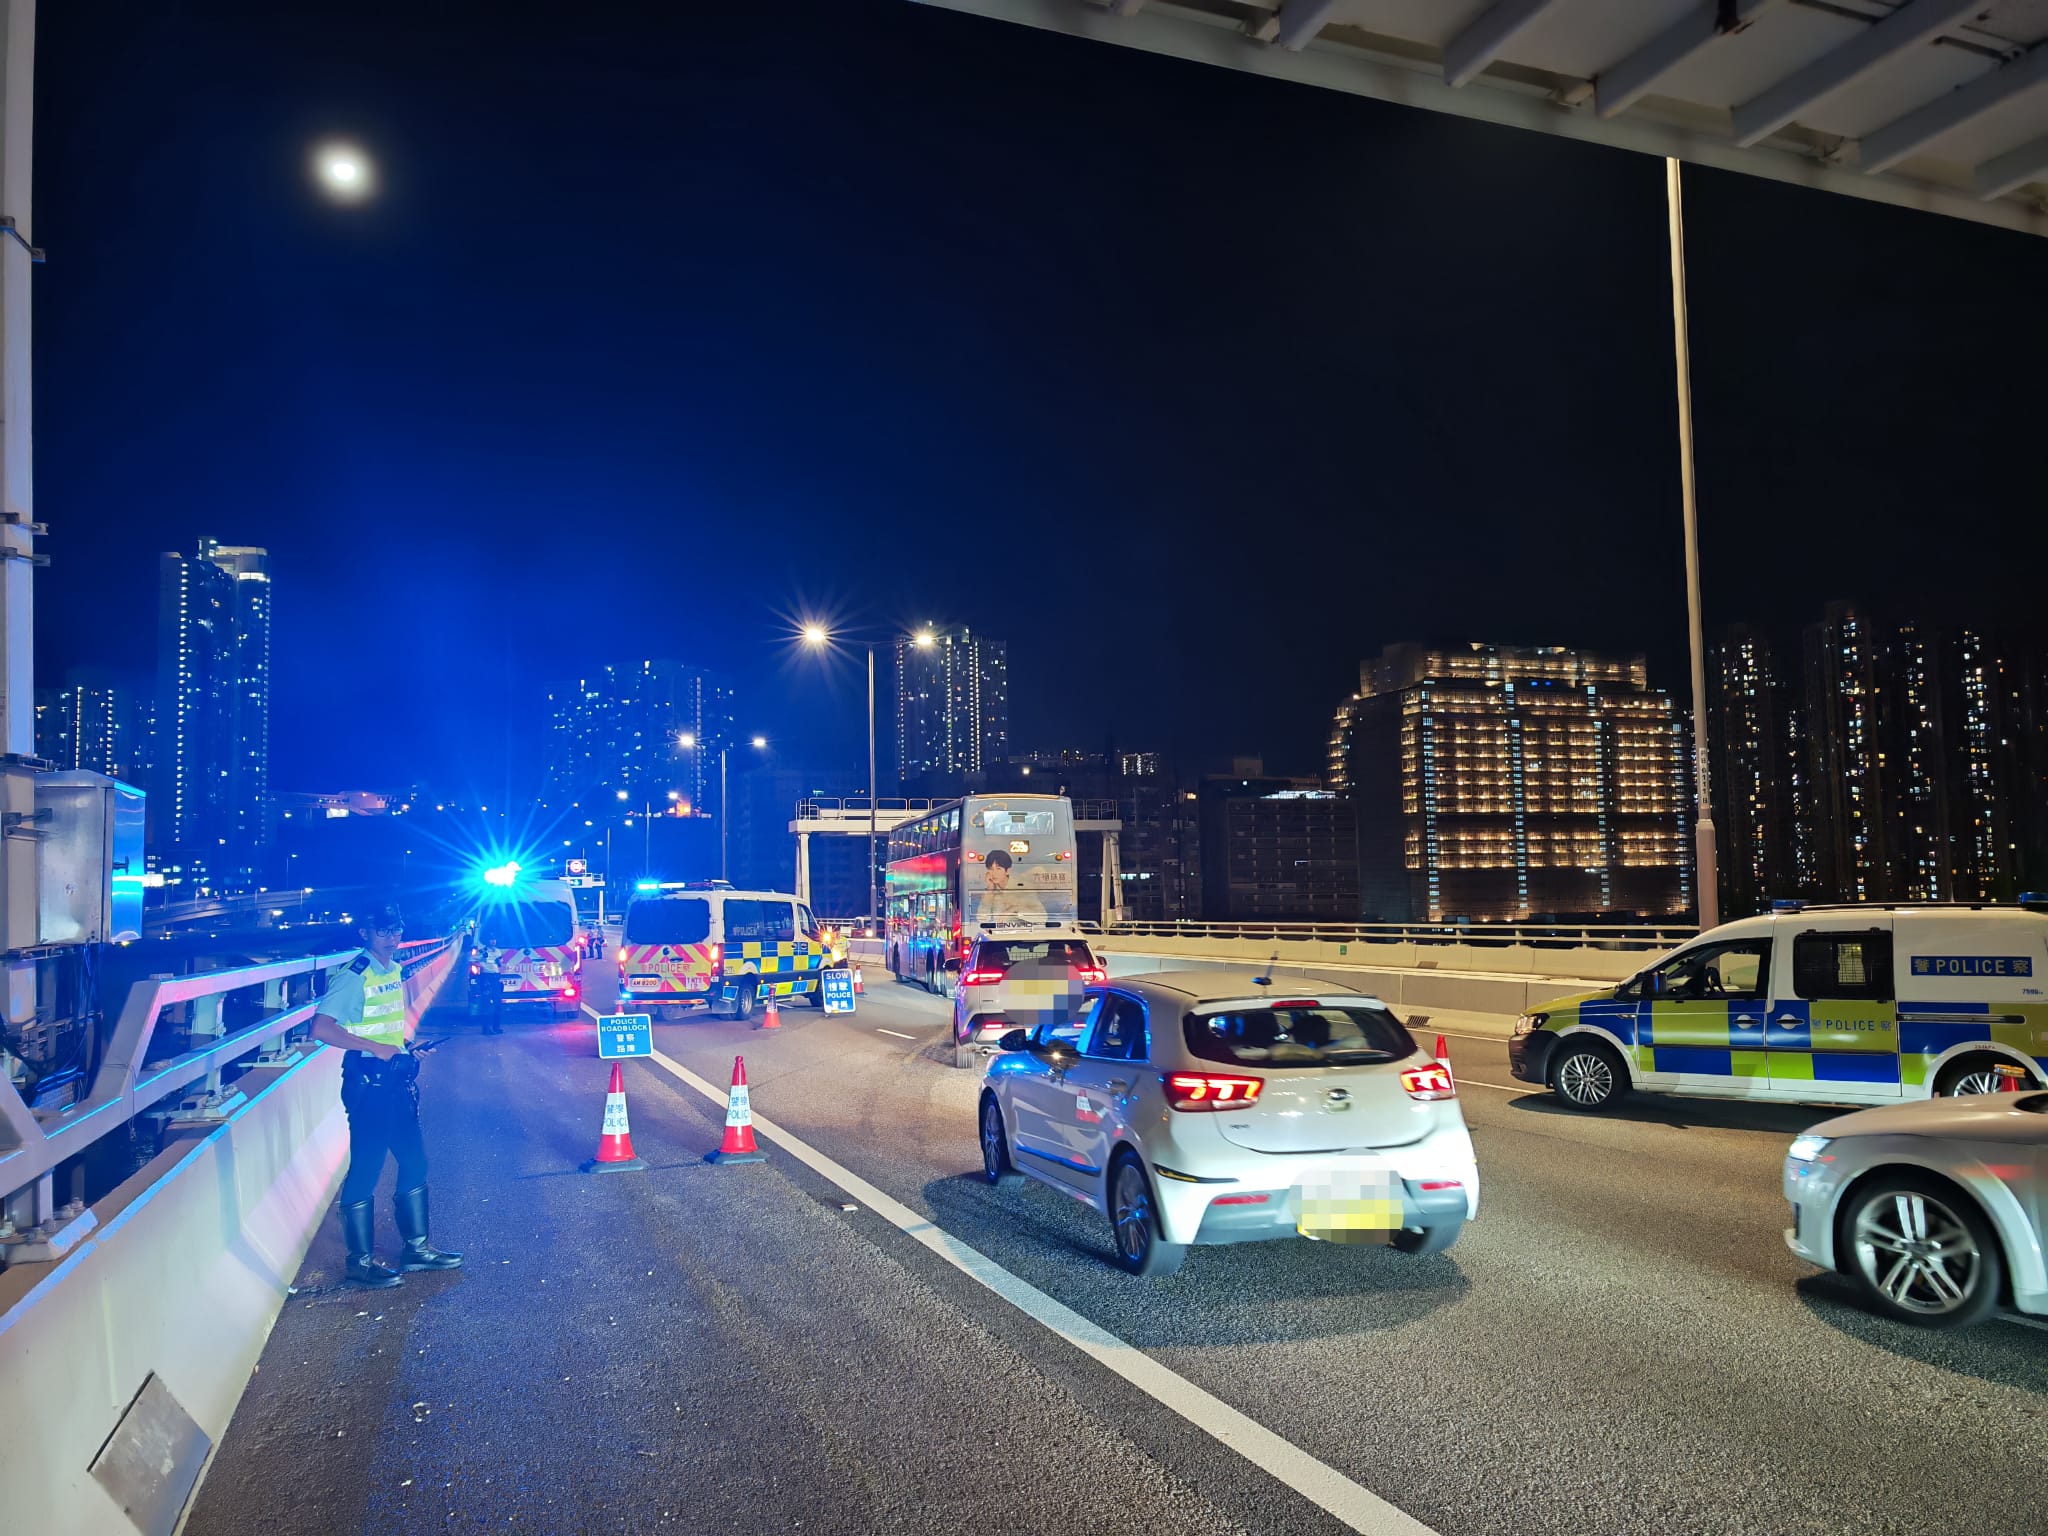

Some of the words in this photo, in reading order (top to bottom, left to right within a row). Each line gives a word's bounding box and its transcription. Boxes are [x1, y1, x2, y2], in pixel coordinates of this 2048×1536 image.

[648, 963, 683, 973] POLICE
[1936, 959, 2006, 974] POLICE
[2012, 960, 2029, 974] 察
[826, 971, 849, 980] SLOW
[827, 991, 852, 999] POLICE
[610, 1018, 637, 1026] POLICE
[1826, 1019, 1876, 1031] POLICE
[601, 1024, 648, 1032] ROADBLOCK
